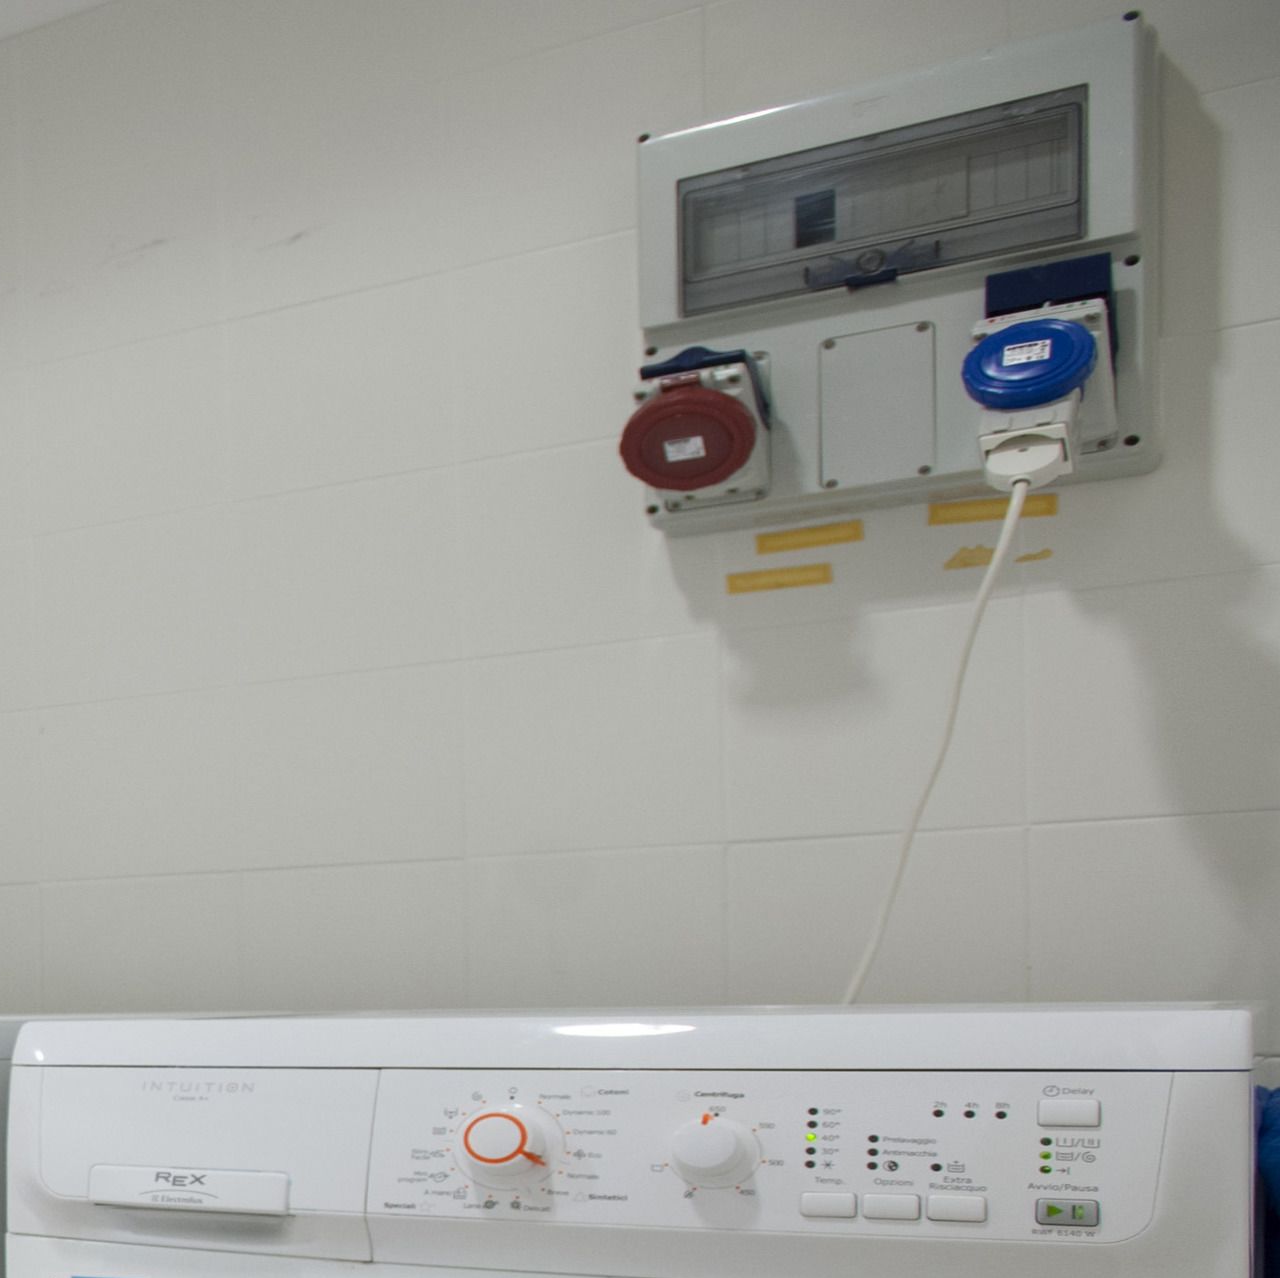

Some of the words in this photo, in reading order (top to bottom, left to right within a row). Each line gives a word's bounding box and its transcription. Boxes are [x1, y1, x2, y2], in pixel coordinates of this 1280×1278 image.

[141, 1081, 256, 1093] INTUITION
[1062, 1087, 1095, 1096] Delay
[154, 1171, 208, 1187] REX
[943, 1176, 972, 1184] Extra
[1028, 1183, 1099, 1193] Avvio/Pausa
